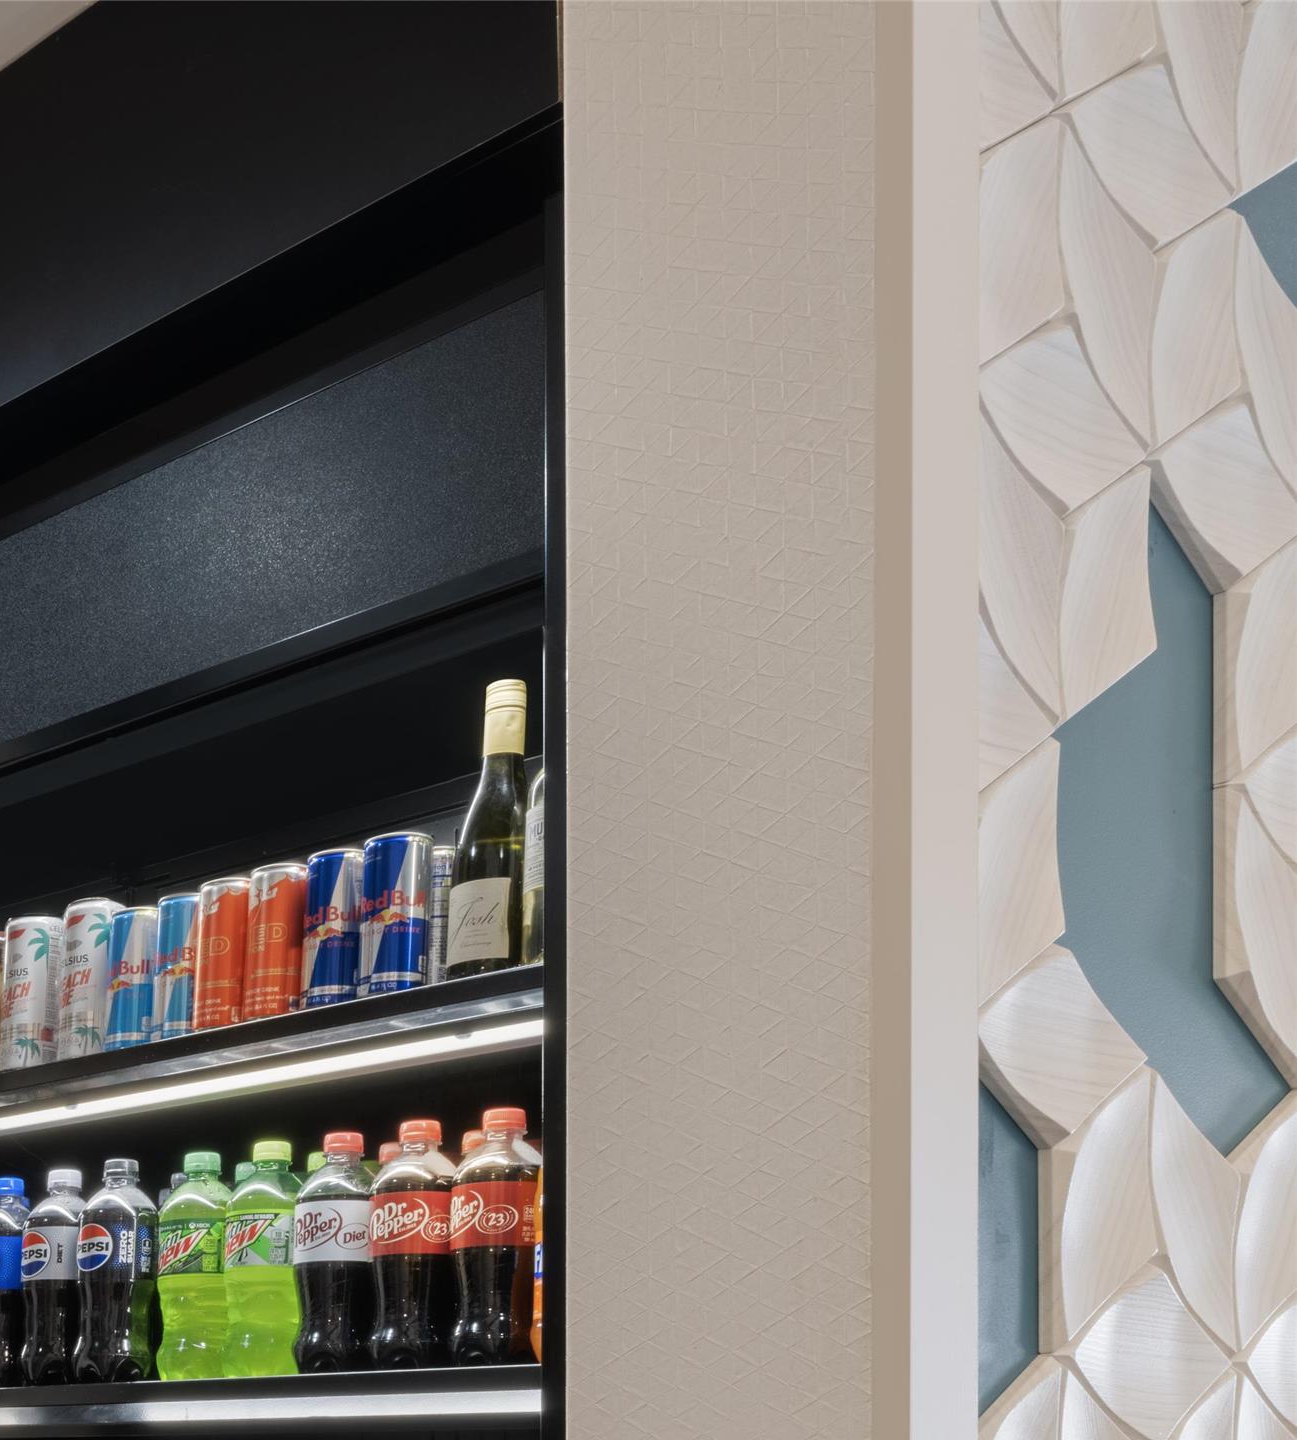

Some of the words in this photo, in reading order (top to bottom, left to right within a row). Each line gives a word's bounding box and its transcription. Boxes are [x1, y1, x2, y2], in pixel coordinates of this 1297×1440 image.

[120, 959, 149, 976] Bull
[383, 1200, 408, 1219] Dr
[487, 1210, 506, 1226] 23
[304, 1212, 322, 1228] Dr
[372, 1208, 423, 1242] Pepper
[433, 1221, 449, 1236] 23
[343, 1229, 366, 1244] Diet
[56, 1243, 64, 1264] DIET
[77, 1240, 110, 1254] PEPSI
[119, 1230, 128, 1264] ZERO
[127, 1230, 135, 1264] SUGAR
